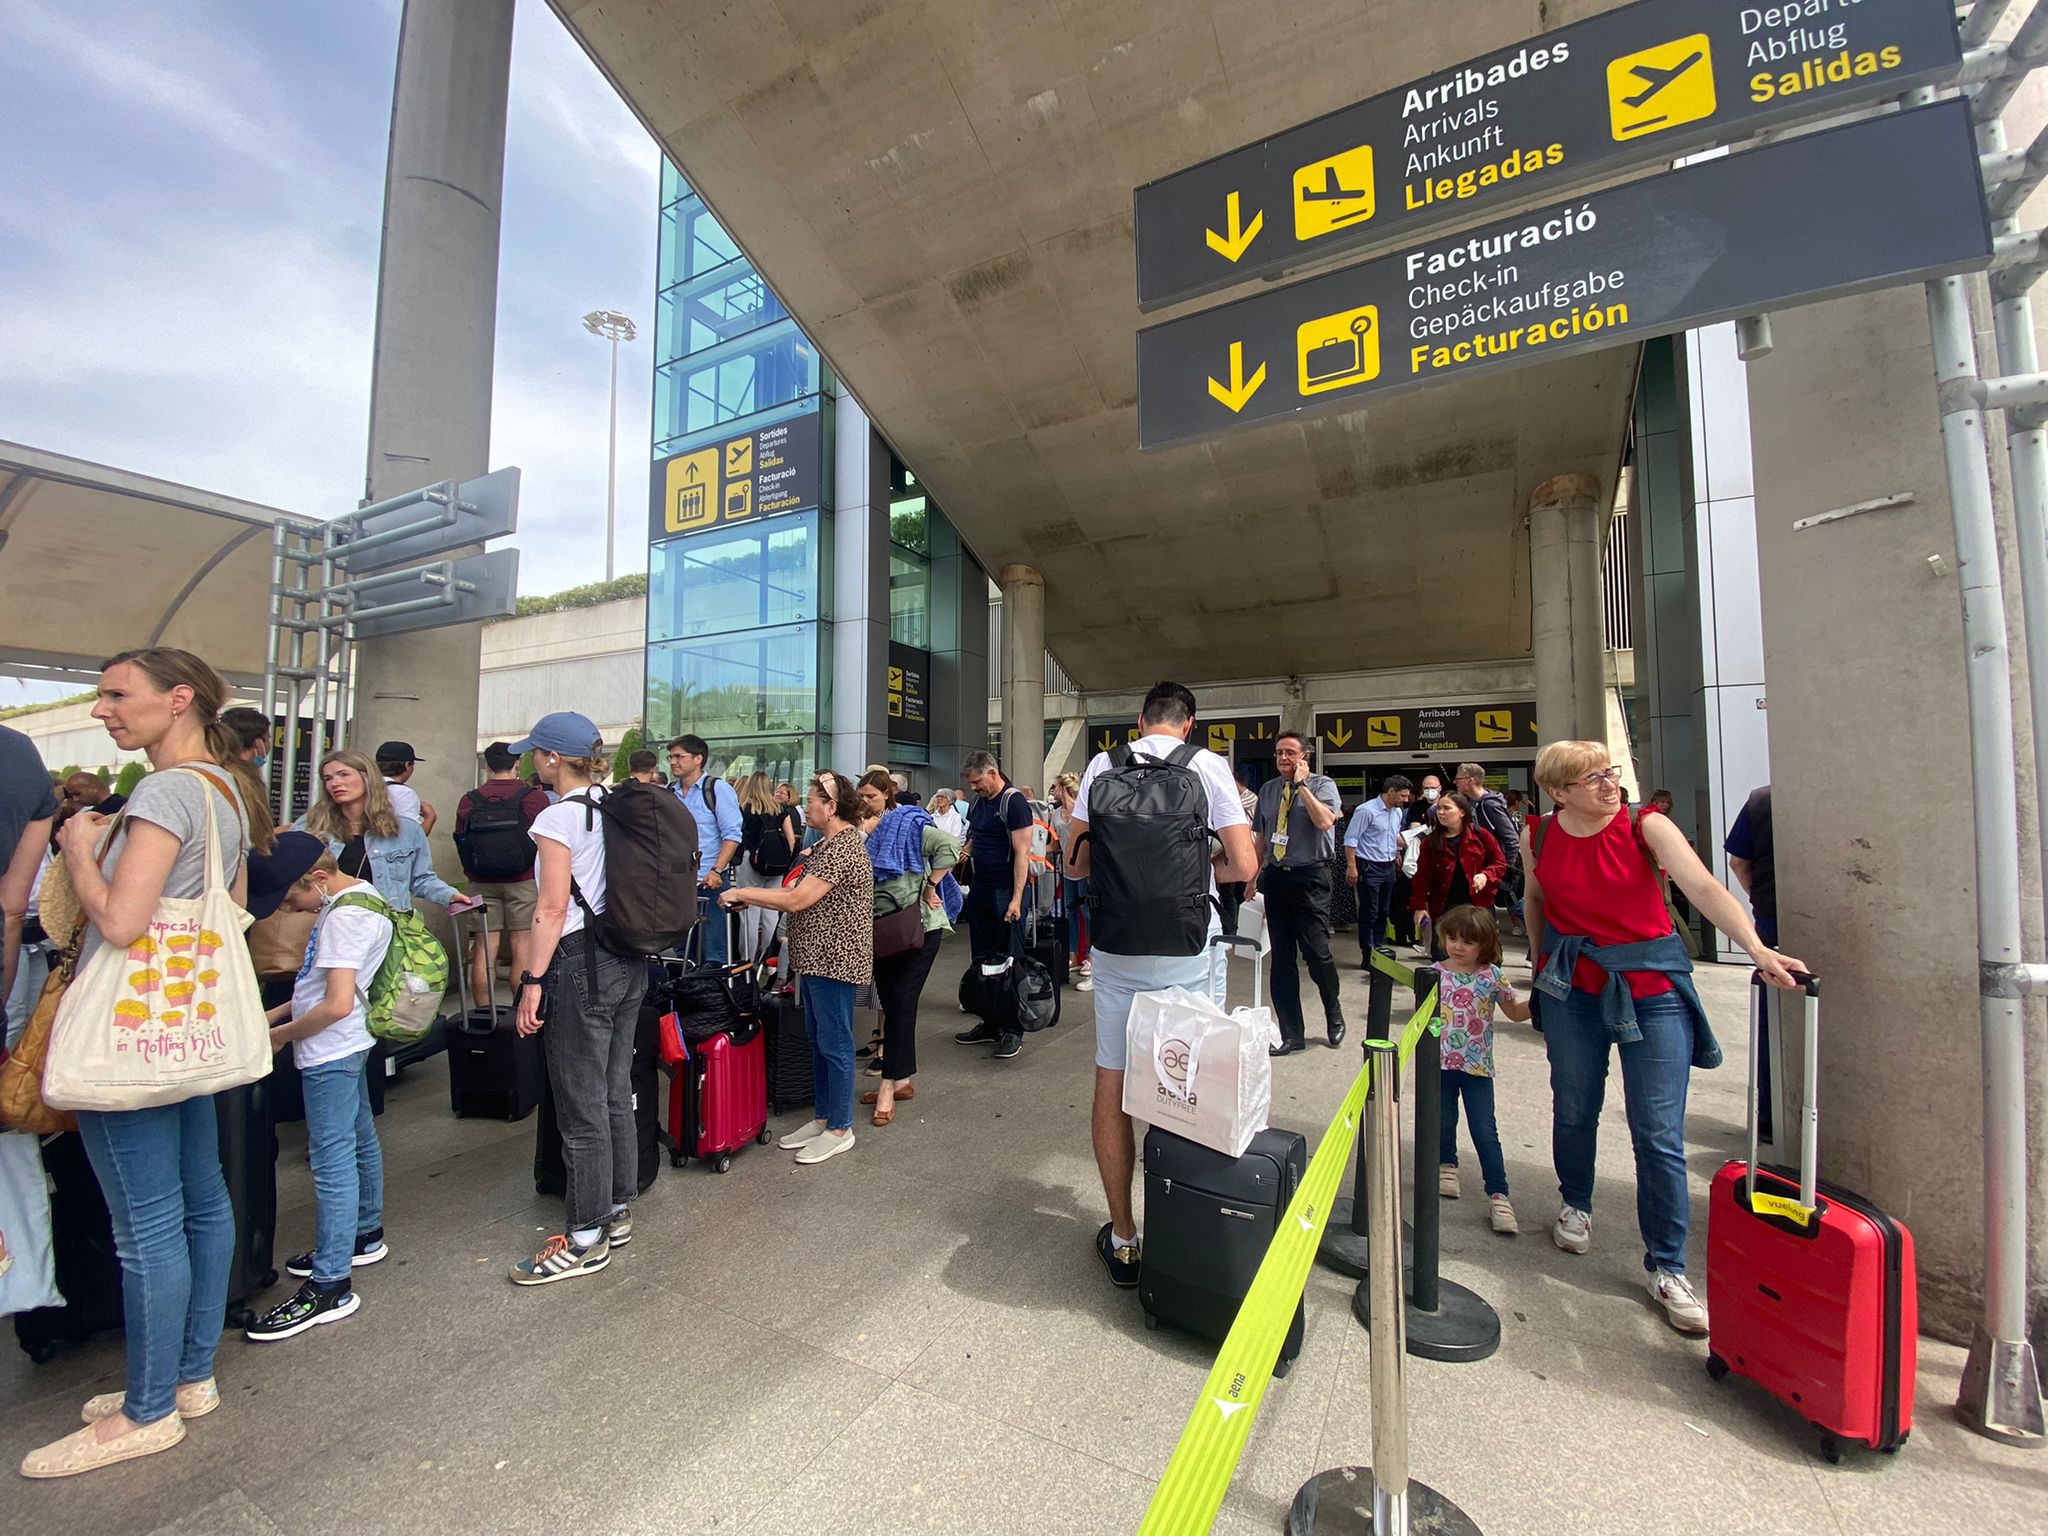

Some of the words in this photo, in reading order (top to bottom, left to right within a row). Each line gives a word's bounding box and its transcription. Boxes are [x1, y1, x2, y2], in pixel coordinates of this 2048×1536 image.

[1740, 0, 1864, 35] Depar
[1747, 22, 1848, 67] Abflug
[1402, 41, 1570, 119] Arribades
[1750, 45, 1902, 103] Salidas
[1403, 99, 1499, 148] Arrivals
[1405, 125, 1504, 177] Ankunft
[1405, 143, 1565, 210] Llegadas
[1406, 203, 1598, 281] Facturació
[1408, 264, 1518, 309] Check-in
[1410, 269, 1625, 339] Gepäckaufgabe
[1411, 302, 1629, 373] Facturación
[760, 427, 788, 441] Sortides
[760, 437, 787, 450] Departures
[759, 466, 796, 484] Facturació
[760, 456, 784, 469] Salidas
[759, 496, 800, 512] Facturación
[1419, 708, 1461, 718] Arribades
[1419, 720, 1445, 729] Arrivals
[1419, 731, 1445, 739] Ankunft
[1420, 741, 1459, 750] Llegadas
[150, 918, 202, 944] upcak
[191, 1026, 226, 1062] hill
[1228, 1372, 1246, 1398] aena
